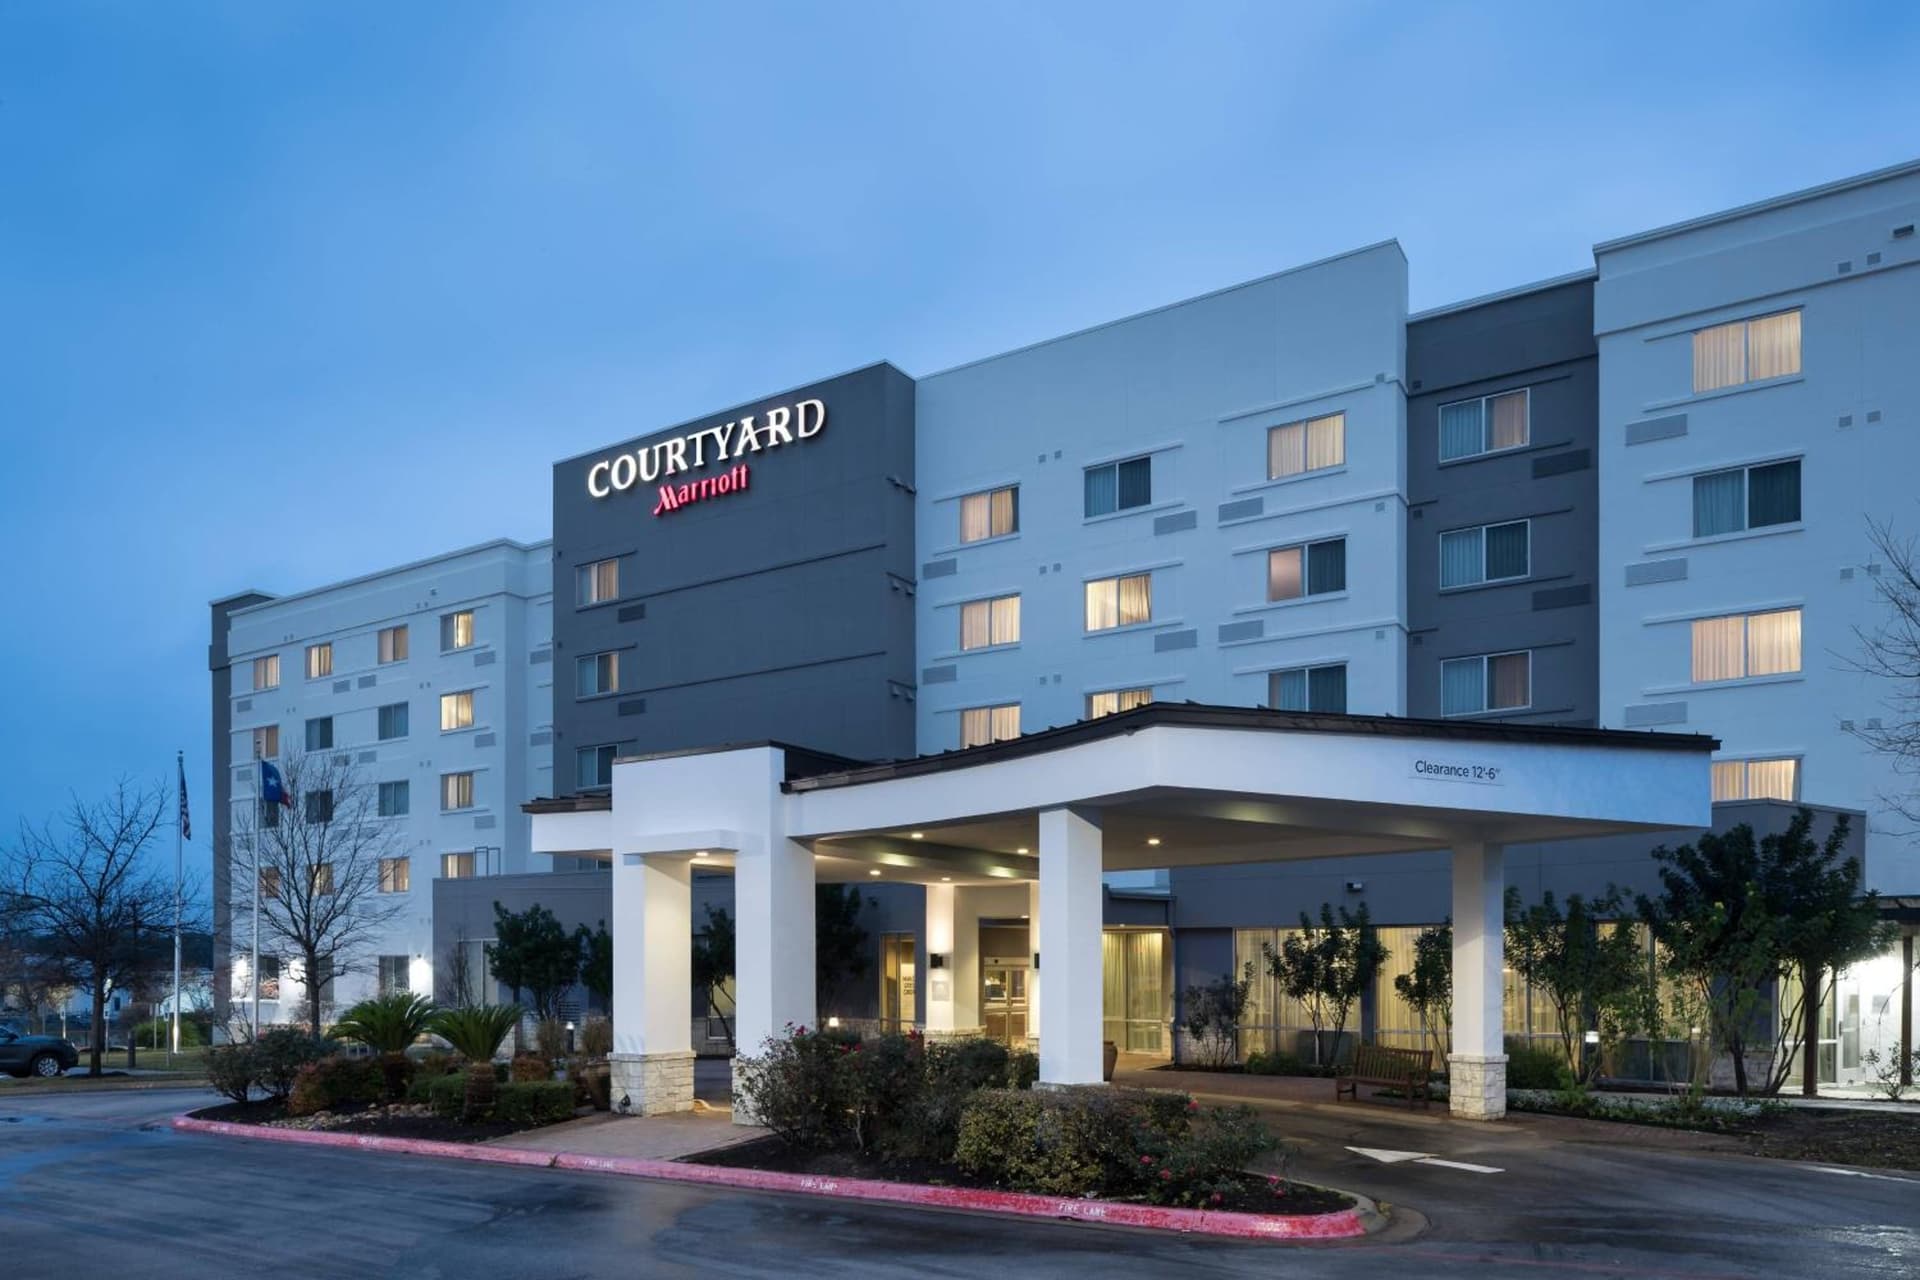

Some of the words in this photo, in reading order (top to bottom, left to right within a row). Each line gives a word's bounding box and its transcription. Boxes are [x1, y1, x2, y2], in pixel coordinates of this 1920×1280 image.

[587, 398, 825, 498] COURTYARD
[653, 463, 749, 516] Marriott
[1415, 760, 1469, 777] Clearance
[1058, 1202, 1080, 1215] FIRE
